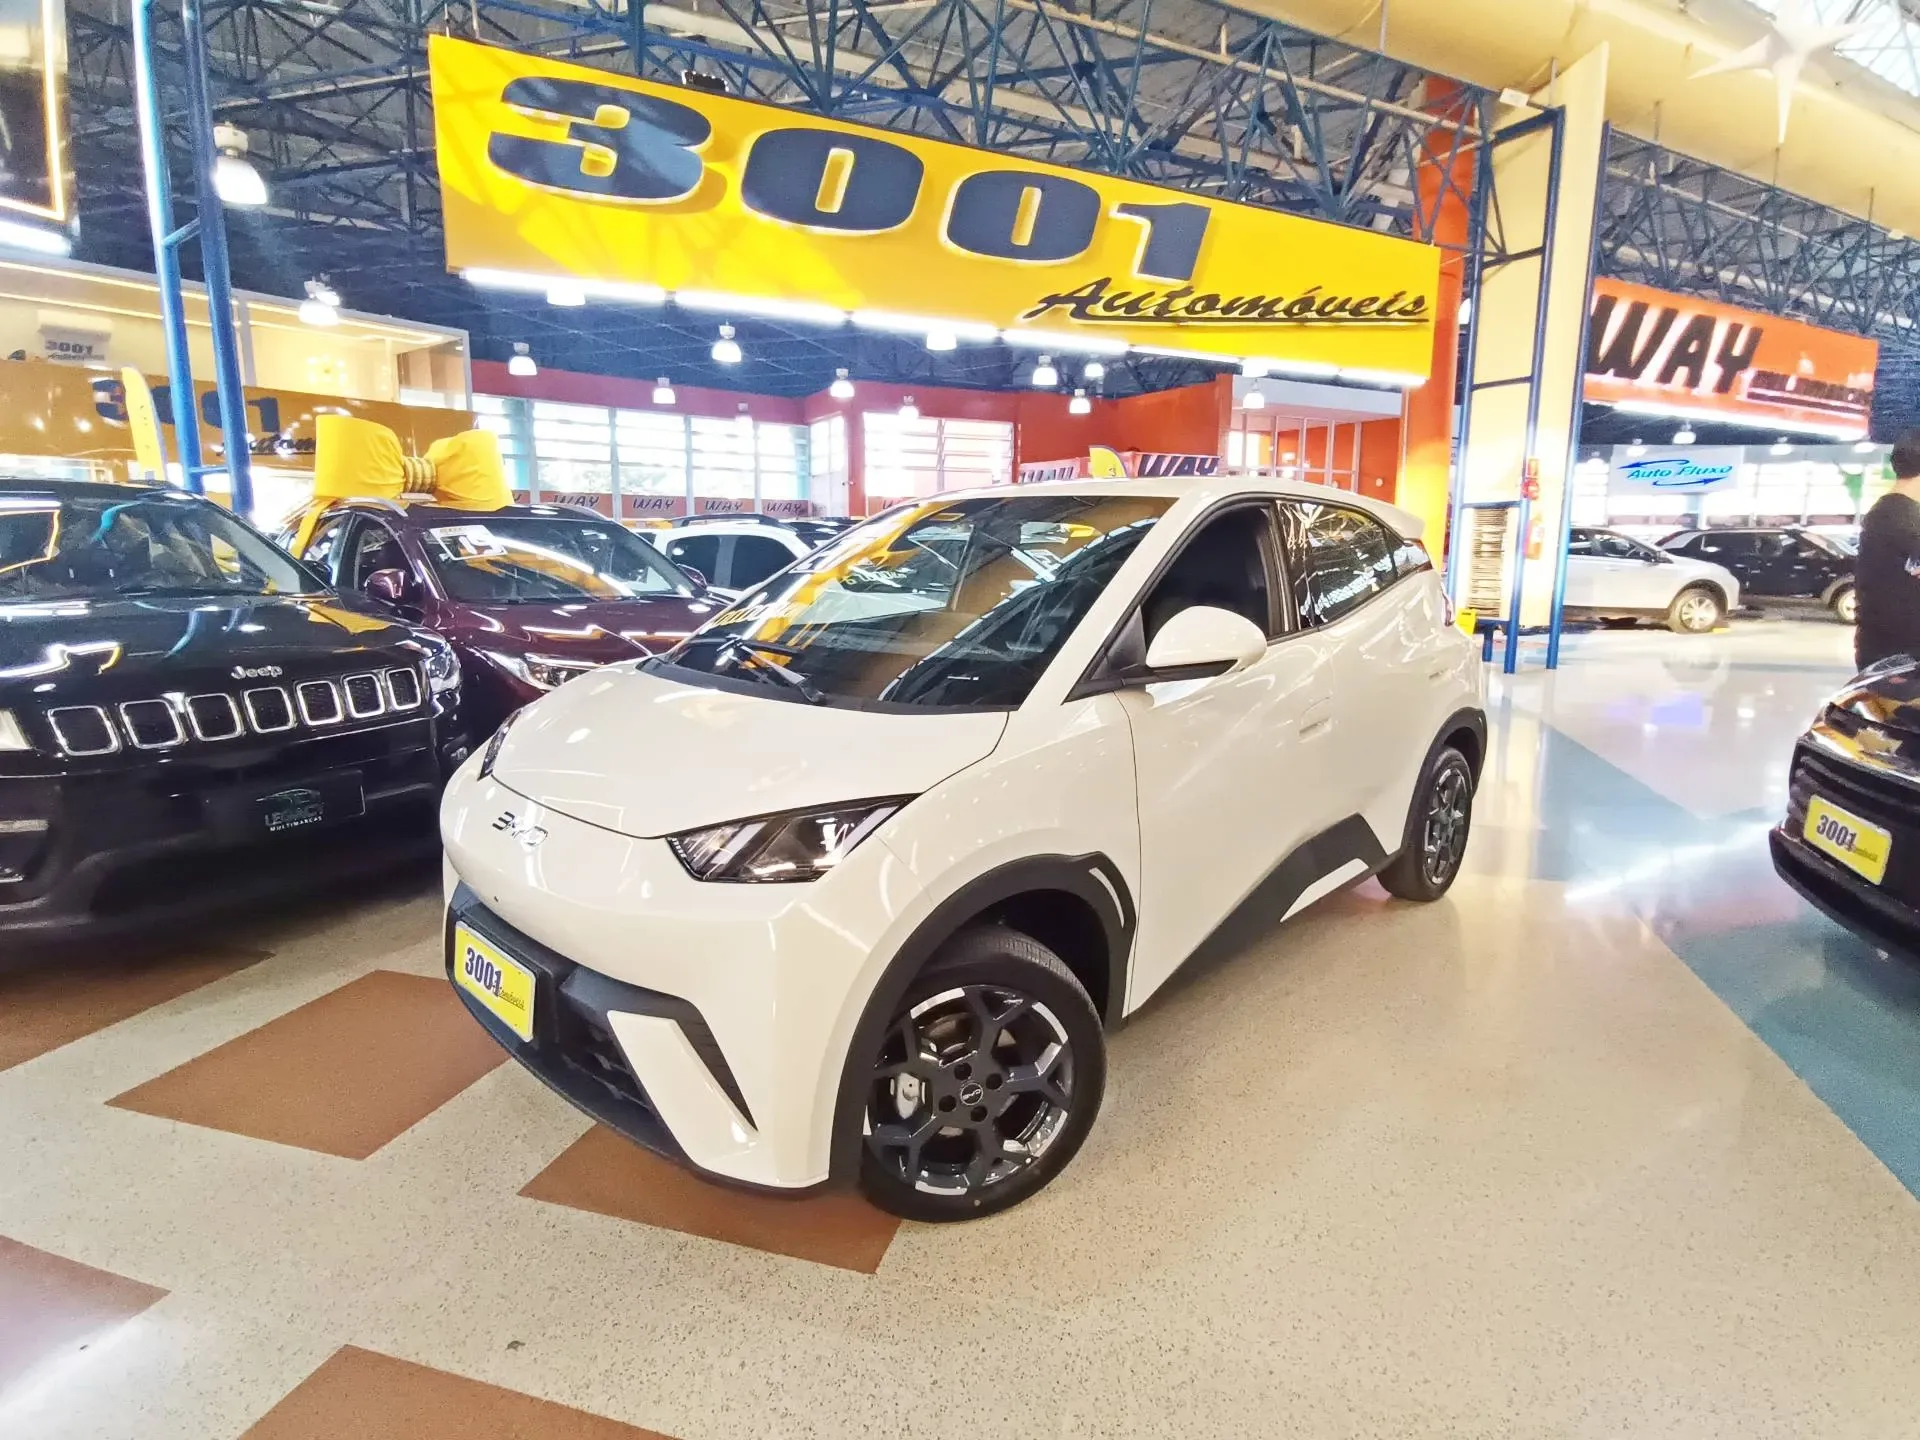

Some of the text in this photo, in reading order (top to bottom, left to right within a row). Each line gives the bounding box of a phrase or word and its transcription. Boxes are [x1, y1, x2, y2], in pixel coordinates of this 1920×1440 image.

[488, 76, 1213, 282] 3001
[1022, 276, 1429, 321] Automóveis
[44, 340, 93, 355] 3001
[1584, 294, 1764, 394] WAY
[1627, 465, 1733, 478] Auto Fluxo
[553, 494, 600, 507] WAY
[633, 498, 674, 510] WAY
[705, 500, 743, 512] WAY
[767, 502, 801, 514] WAY
[230, 665, 283, 680] Jeep
[1816, 814, 1857, 852] 3001
[465, 946, 502, 998] 3001
